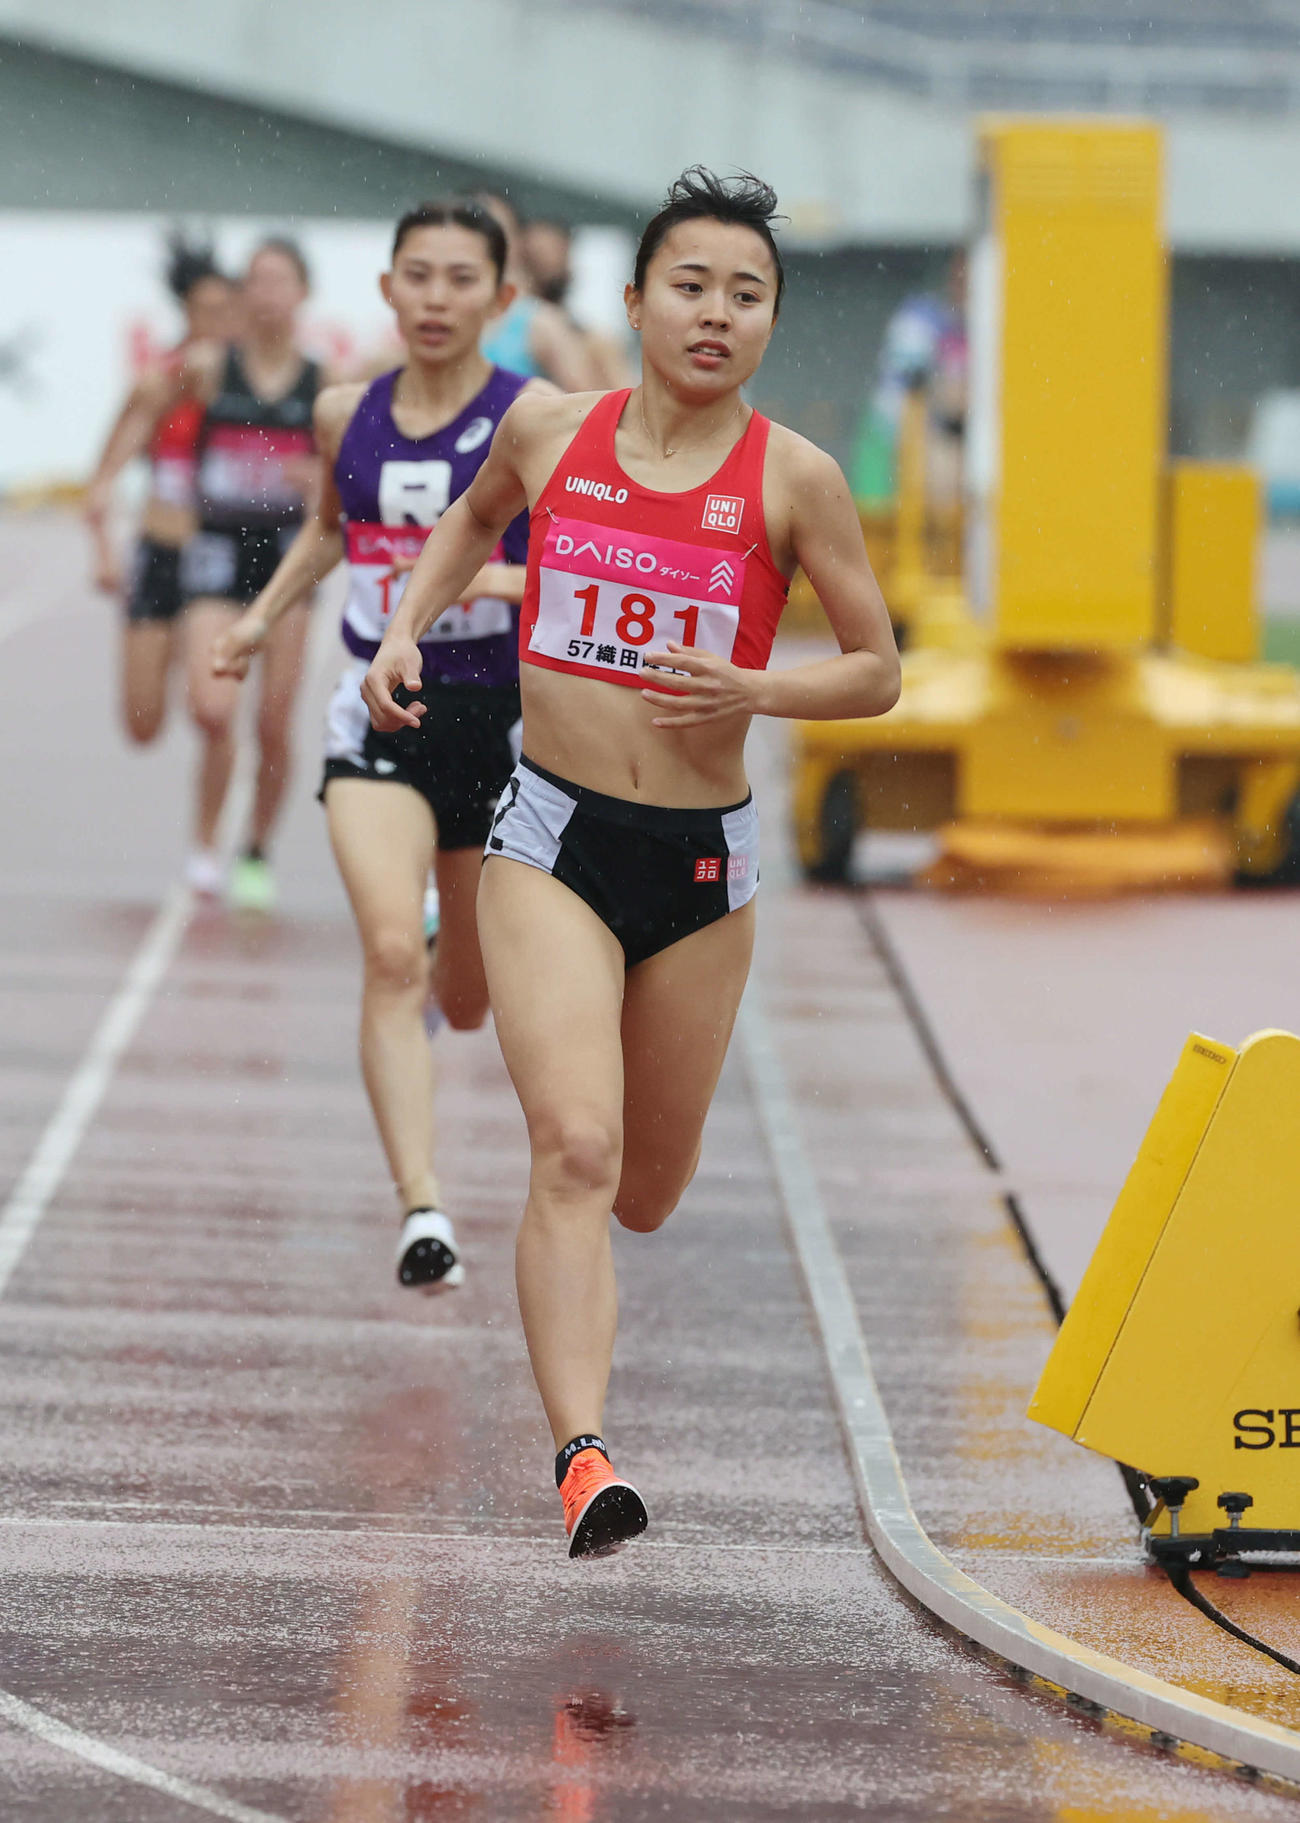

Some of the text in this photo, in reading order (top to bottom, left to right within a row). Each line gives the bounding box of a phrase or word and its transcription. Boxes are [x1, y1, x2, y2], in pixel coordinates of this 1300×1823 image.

[565, 476, 628, 504] UNIQLO
[708, 512, 736, 528] QLO
[711, 500, 736, 514] UNI
[555, 534, 657, 573] DAISO
[659, 566, 700, 581] ダイソー
[574, 584, 699, 648] 181
[567, 639, 687, 676] 57織田
